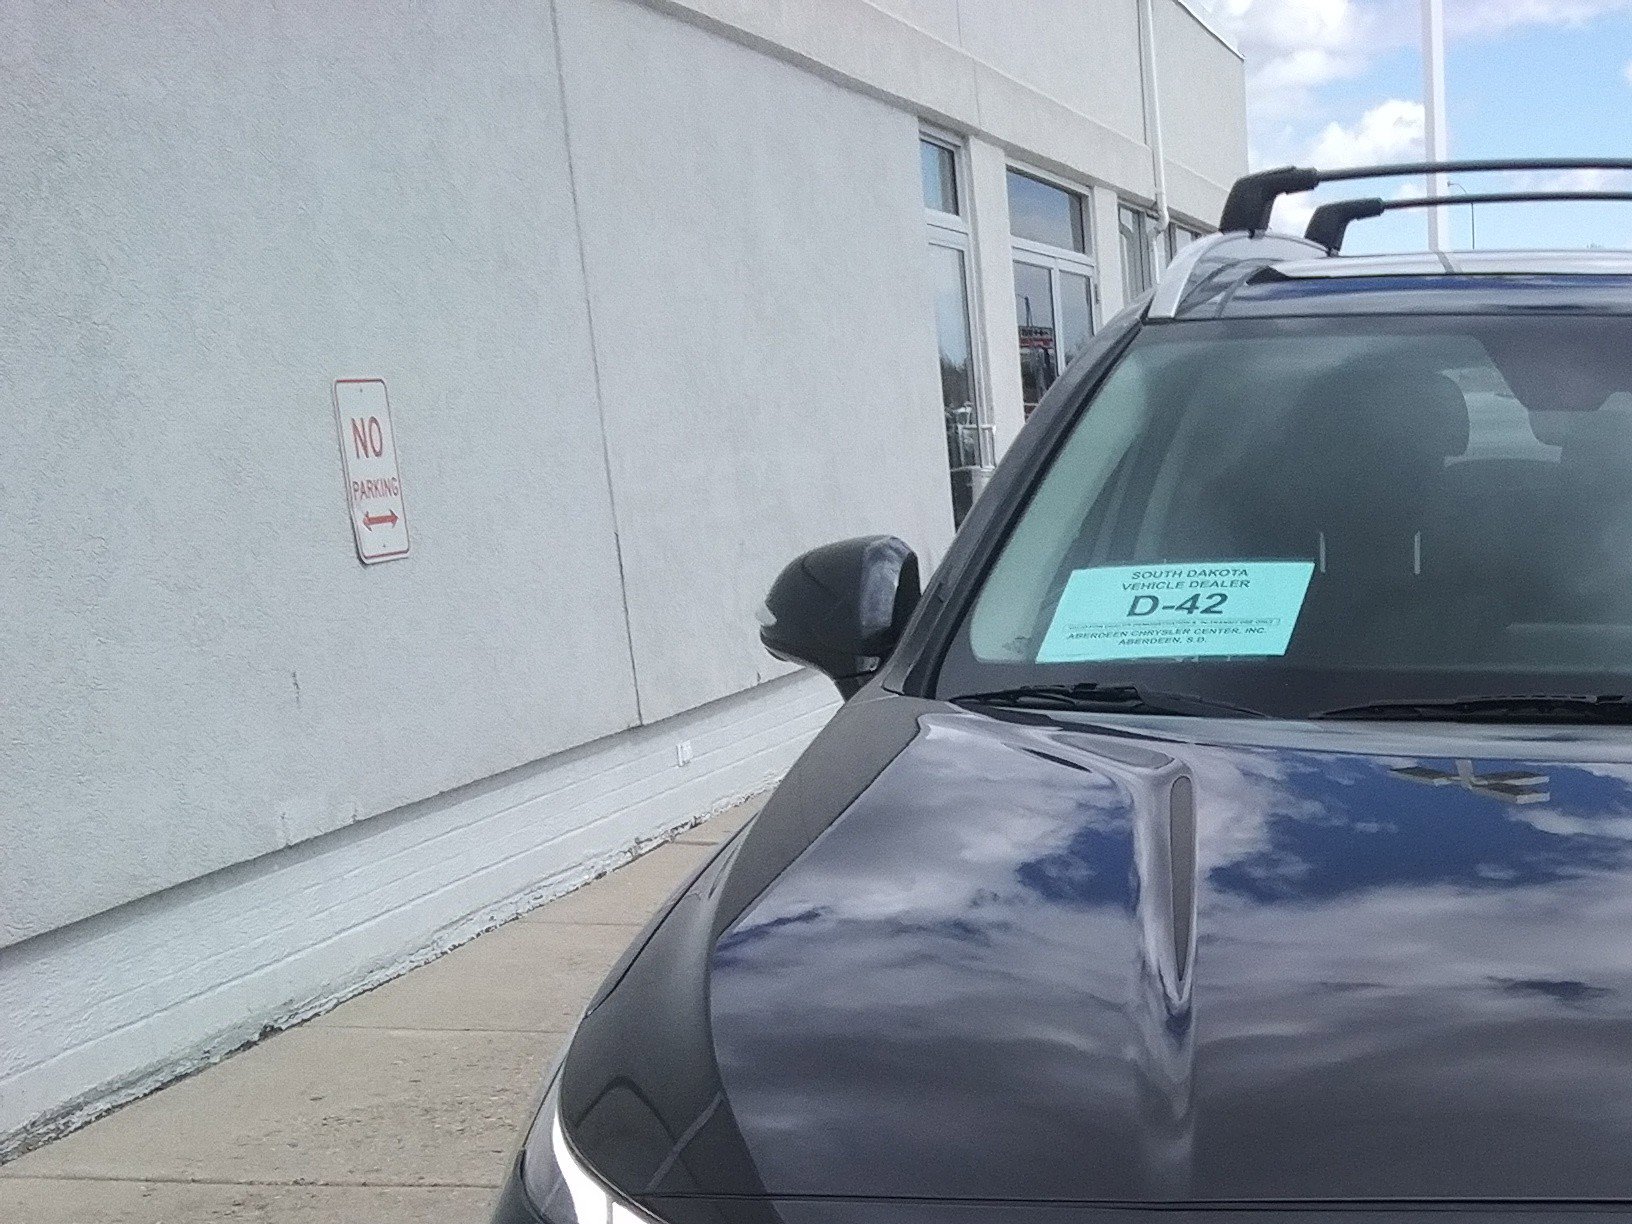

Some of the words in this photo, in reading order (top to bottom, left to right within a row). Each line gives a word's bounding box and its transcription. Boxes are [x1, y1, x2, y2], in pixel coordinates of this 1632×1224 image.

[351, 415, 384, 460] NO
[352, 476, 399, 501] PARKING
[1131, 570, 1183, 580] SOUTH
[1186, 569, 1249, 578] DAKOTA
[1122, 581, 1186, 591] VEHICLE
[1188, 580, 1251, 589] DEALER
[1126, 592, 1229, 618] D-42
[1067, 630, 1128, 640] ABERDEEN
[1131, 628, 1192, 637] CHRYSLER
